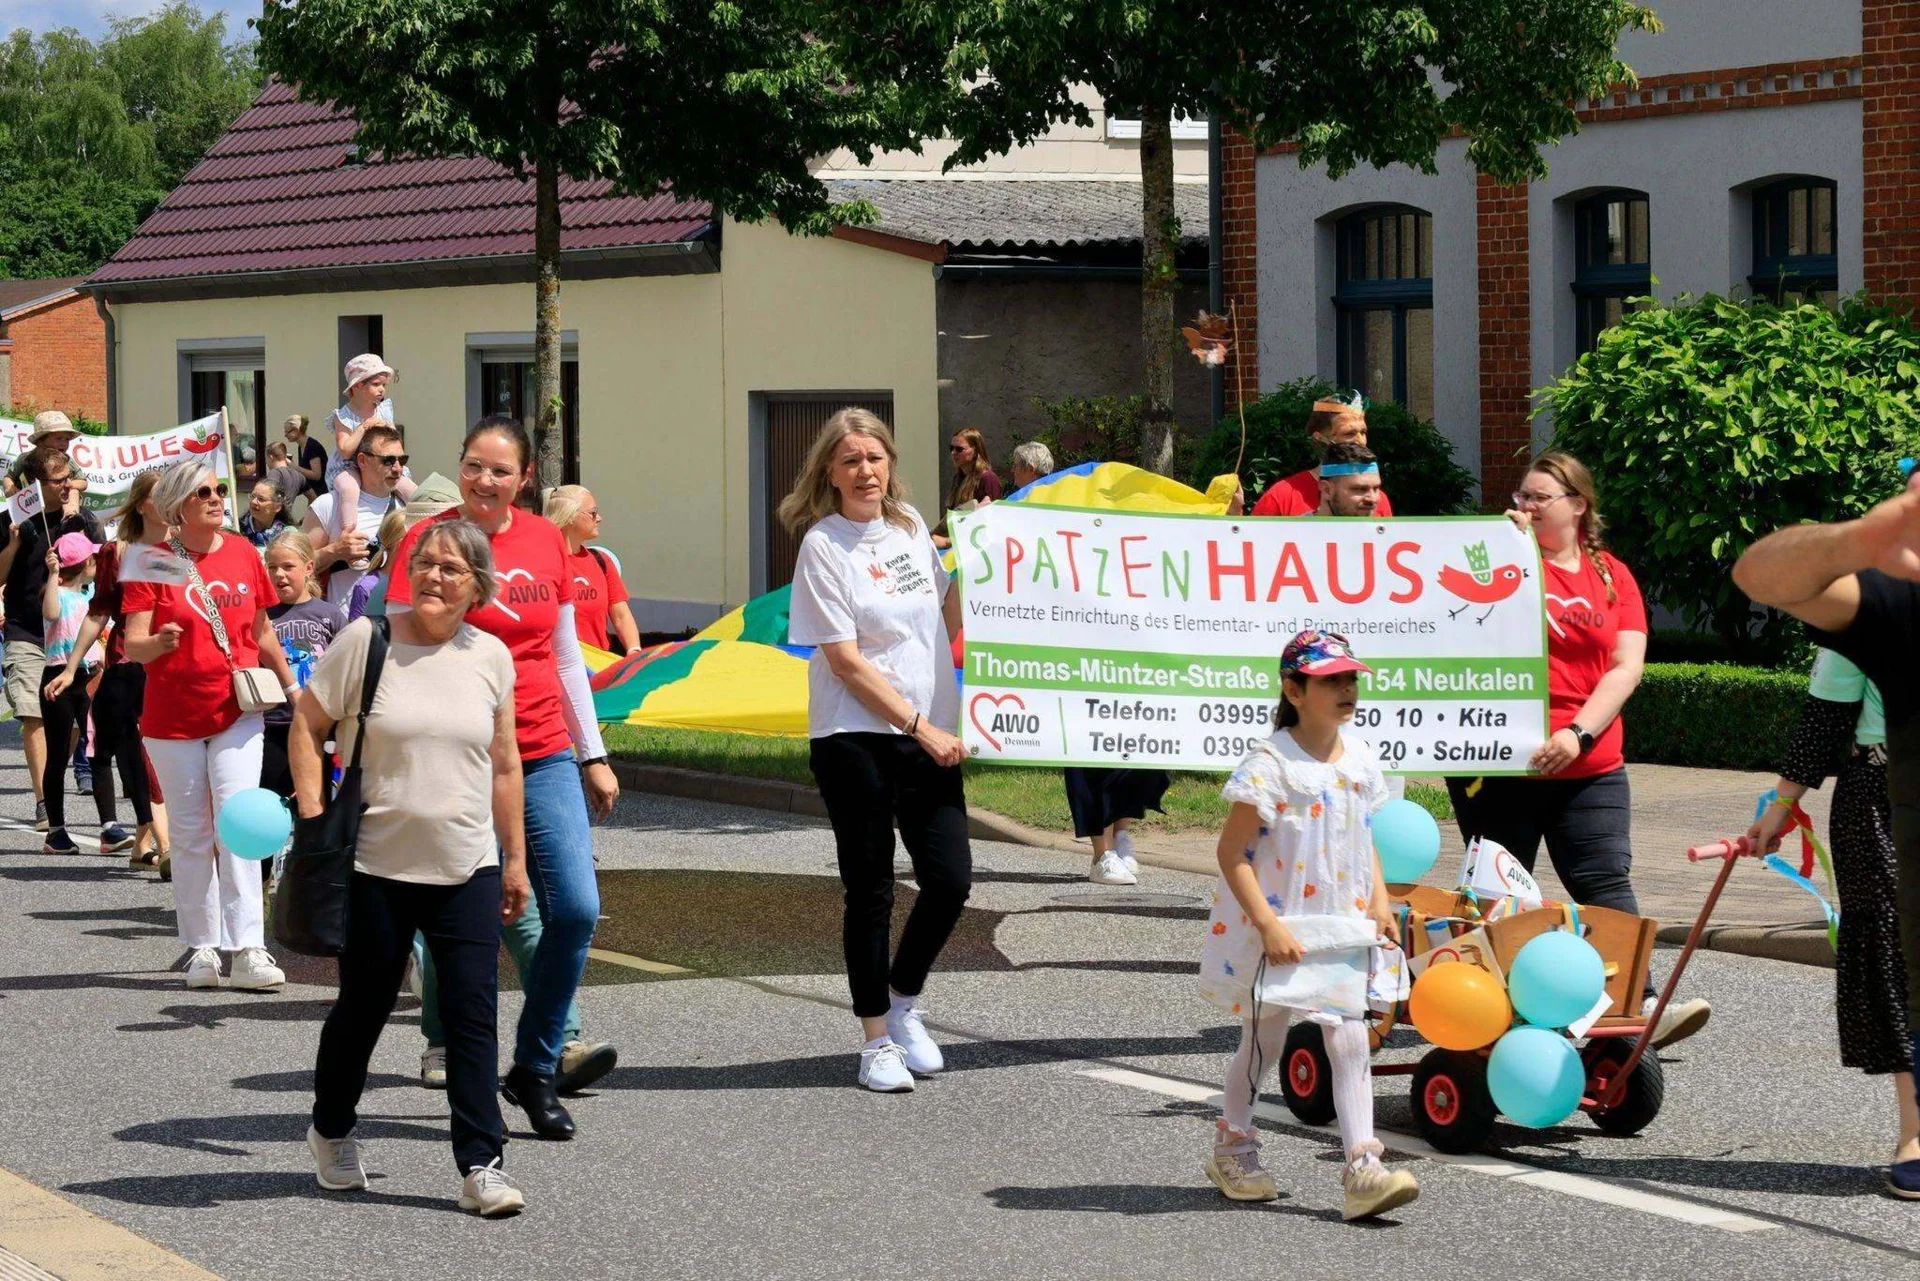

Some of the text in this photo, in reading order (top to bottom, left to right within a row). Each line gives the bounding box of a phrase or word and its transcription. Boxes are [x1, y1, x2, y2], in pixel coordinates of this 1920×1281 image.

[72, 435, 180, 469] CHULE
[884, 553, 911, 570] KINDER
[212, 593, 242, 609] WO
[508, 583, 550, 604] AWO
[575, 588, 598, 601] WO
[969, 600, 1436, 634] Vernetzte Einrichtung des Elementar- und Primarbereiches
[1559, 611, 1604, 628] AWO
[971, 651, 1534, 692] Thomas-Müntzer-Straße 154 Neukalen
[991, 713, 1040, 734] AWO
[1085, 698, 1177, 723] Telefon:
[1354, 708, 1381, 727] 50
[1396, 708, 1423, 727] 10
[1459, 707, 1507, 727] Kita
[1089, 731, 1181, 756] Telefon:
[1379, 740, 1406, 761] 20
[1433, 740, 1513, 761] Schule
[1506, 867, 1532, 890] AWO
